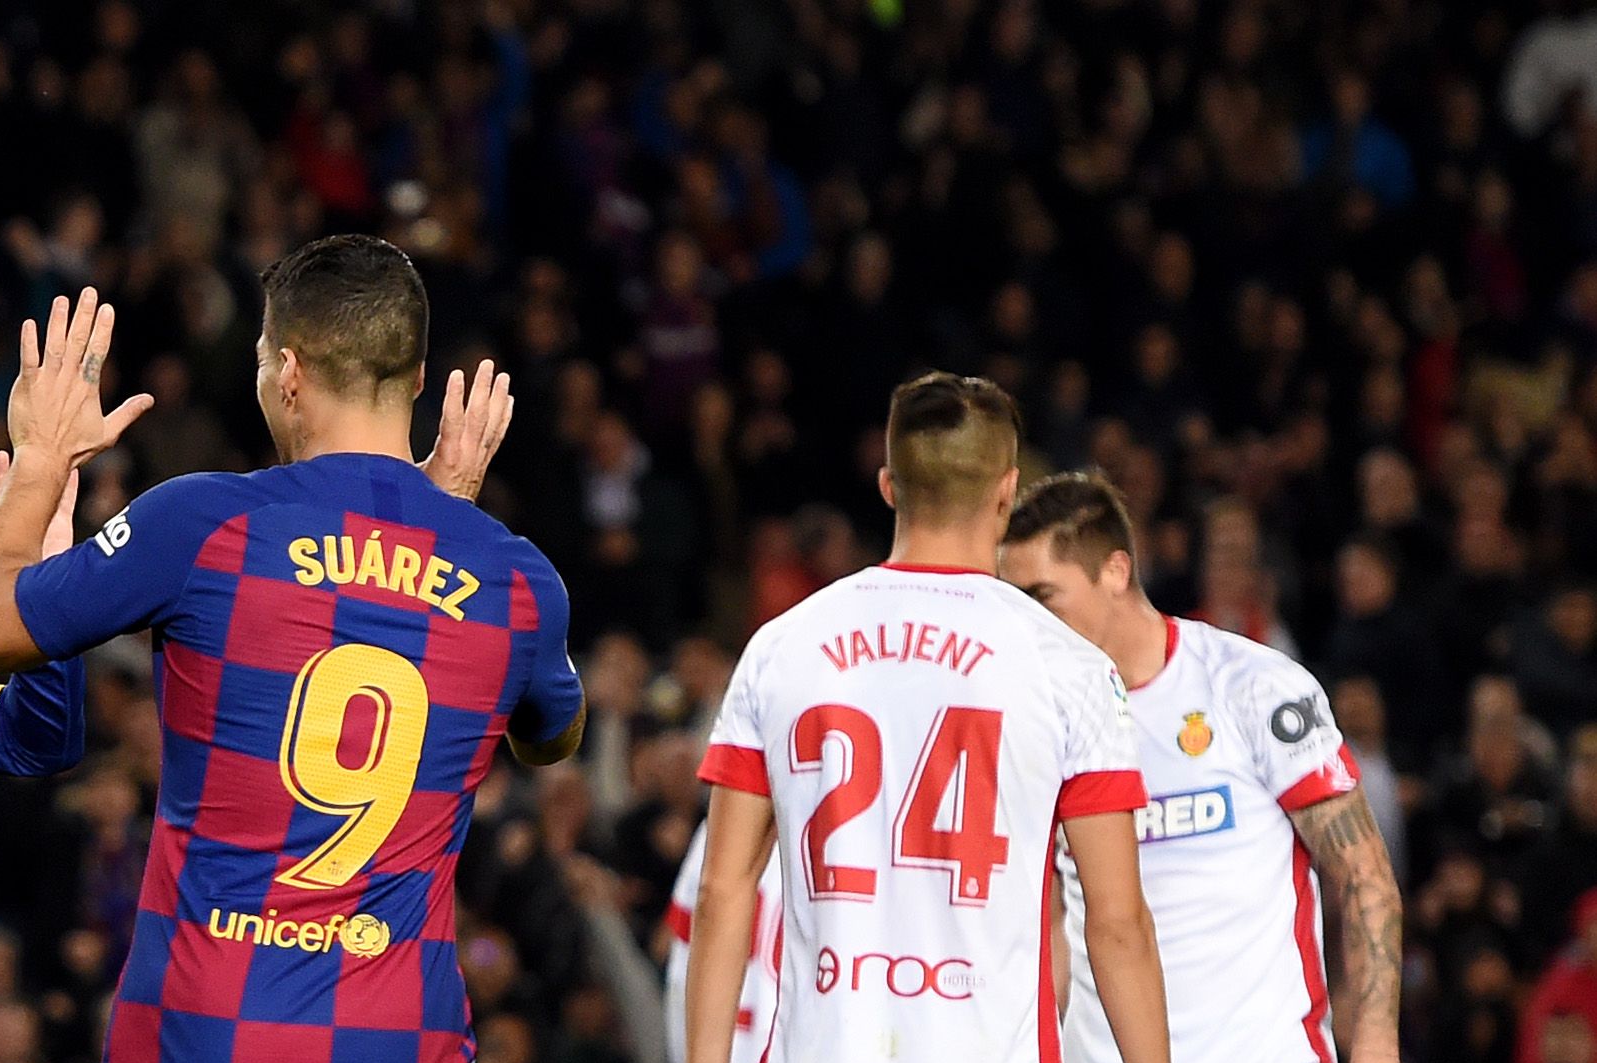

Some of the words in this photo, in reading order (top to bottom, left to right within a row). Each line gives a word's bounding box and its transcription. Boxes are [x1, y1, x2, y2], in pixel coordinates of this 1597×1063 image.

[288, 529, 481, 622] SUÁREZ
[820, 620, 995, 677] VALJENT
[274, 643, 430, 889] 9
[788, 702, 1009, 908] 24
[208, 908, 346, 954] unicef
